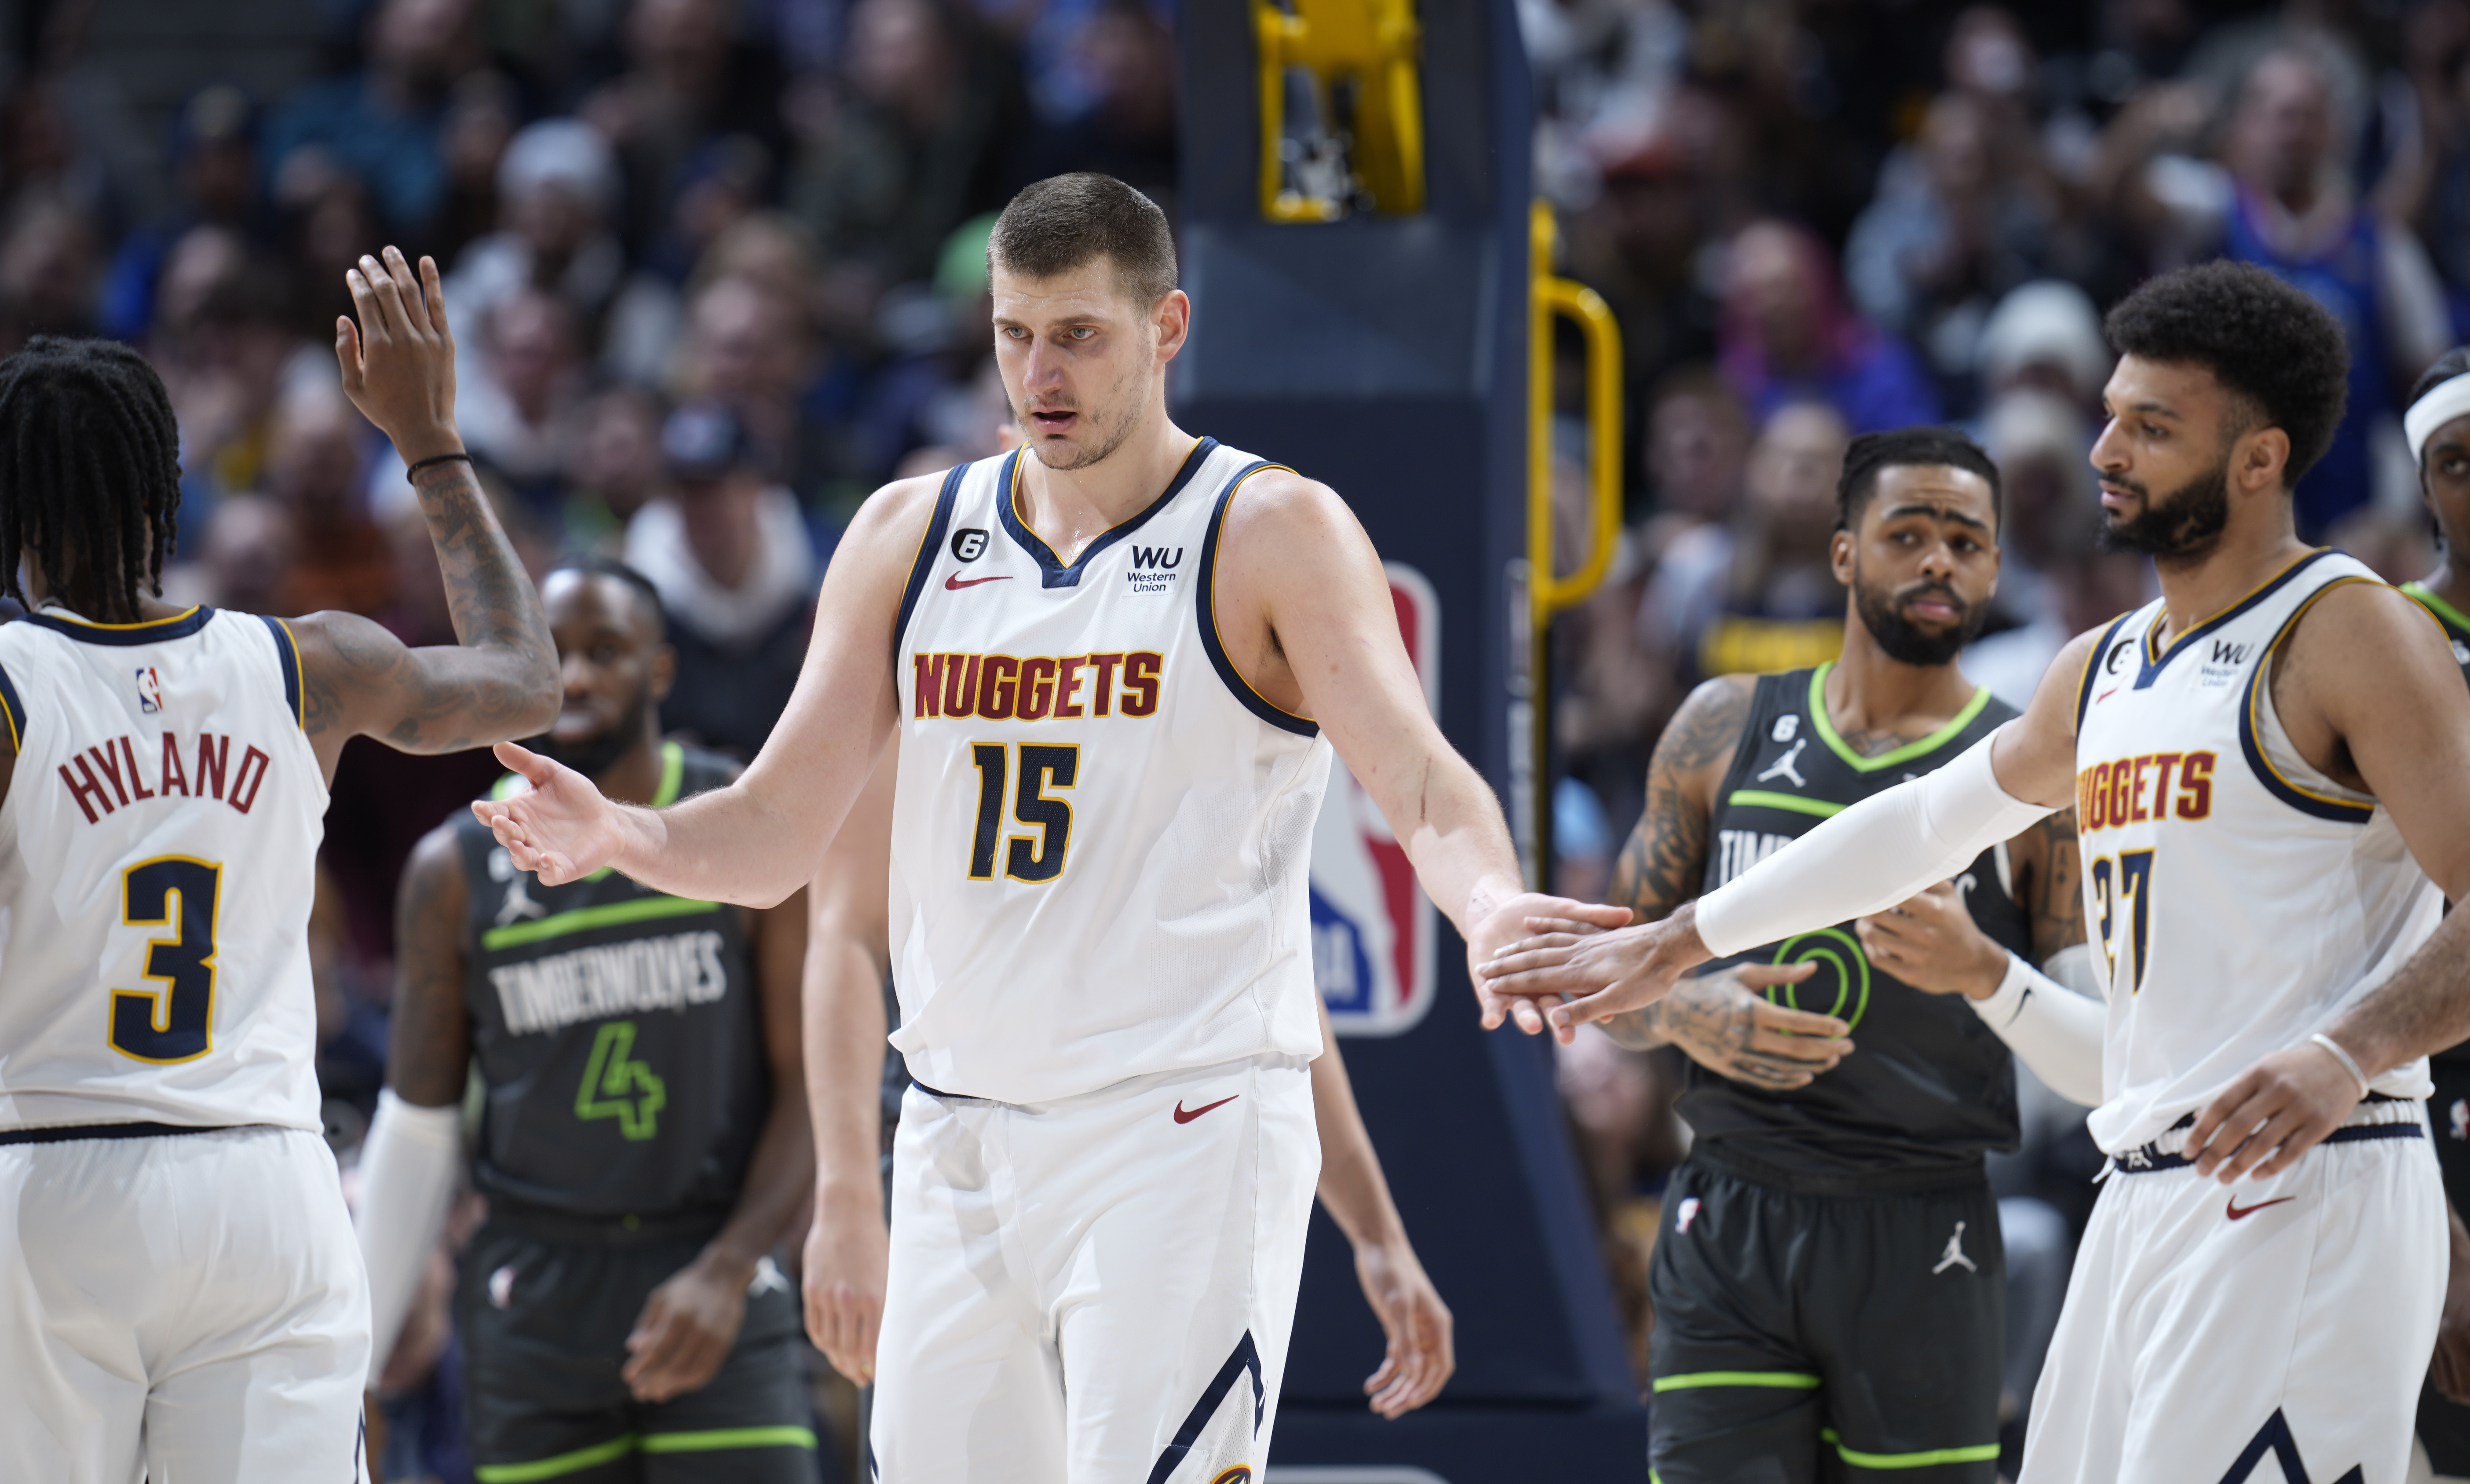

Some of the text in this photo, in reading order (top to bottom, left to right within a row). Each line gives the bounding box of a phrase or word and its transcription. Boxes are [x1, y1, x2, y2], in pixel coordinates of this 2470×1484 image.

[958, 532, 985, 559] 6
[1132, 545, 1184, 569] WU
[1127, 572, 1176, 582] Western
[1133, 582, 1166, 592] Union
[2212, 640, 2256, 664] WU
[913, 651, 1164, 722] NUGGETS
[1771, 714, 1800, 742] 6
[58, 731, 270, 825] HYLAND
[967, 742, 1081, 884] 15
[107, 854, 223, 1065] 3
[488, 929, 728, 1038] TIMBERWOLVES
[574, 1020, 668, 1140] 4
